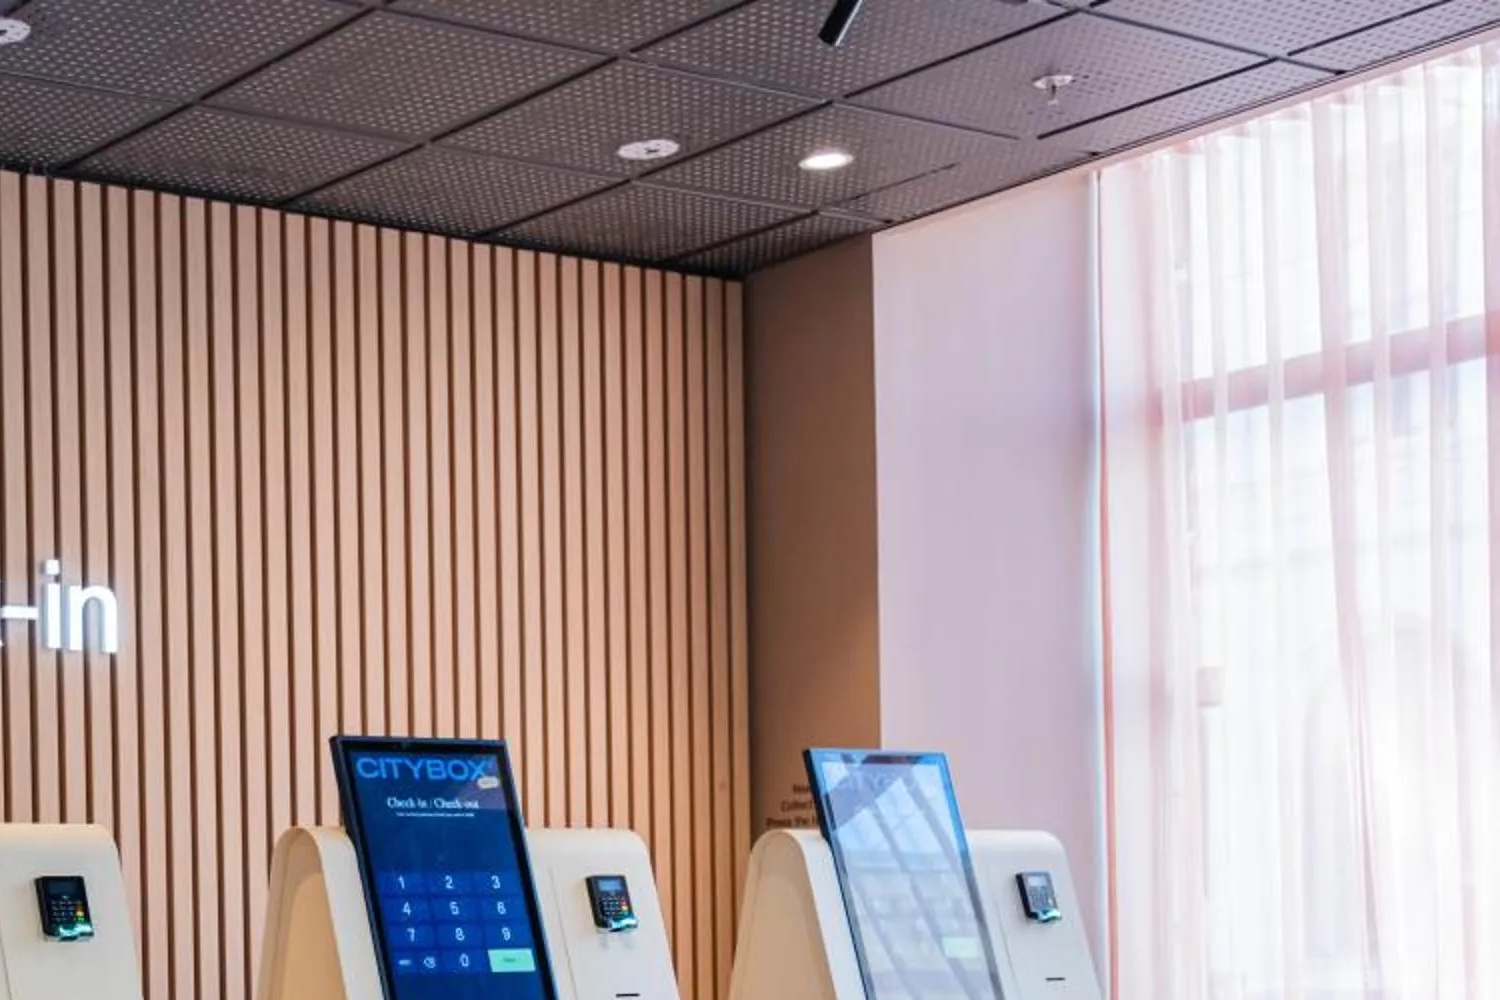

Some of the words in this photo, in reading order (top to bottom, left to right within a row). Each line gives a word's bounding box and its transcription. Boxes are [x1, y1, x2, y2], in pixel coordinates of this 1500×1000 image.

[445, 875, 454, 889] 2
[491, 875, 501, 889] 3
[402, 901, 412, 916] 4
[449, 901, 460, 915] 5
[407, 927, 415, 941] 7
[501, 927, 511, 941] 9
